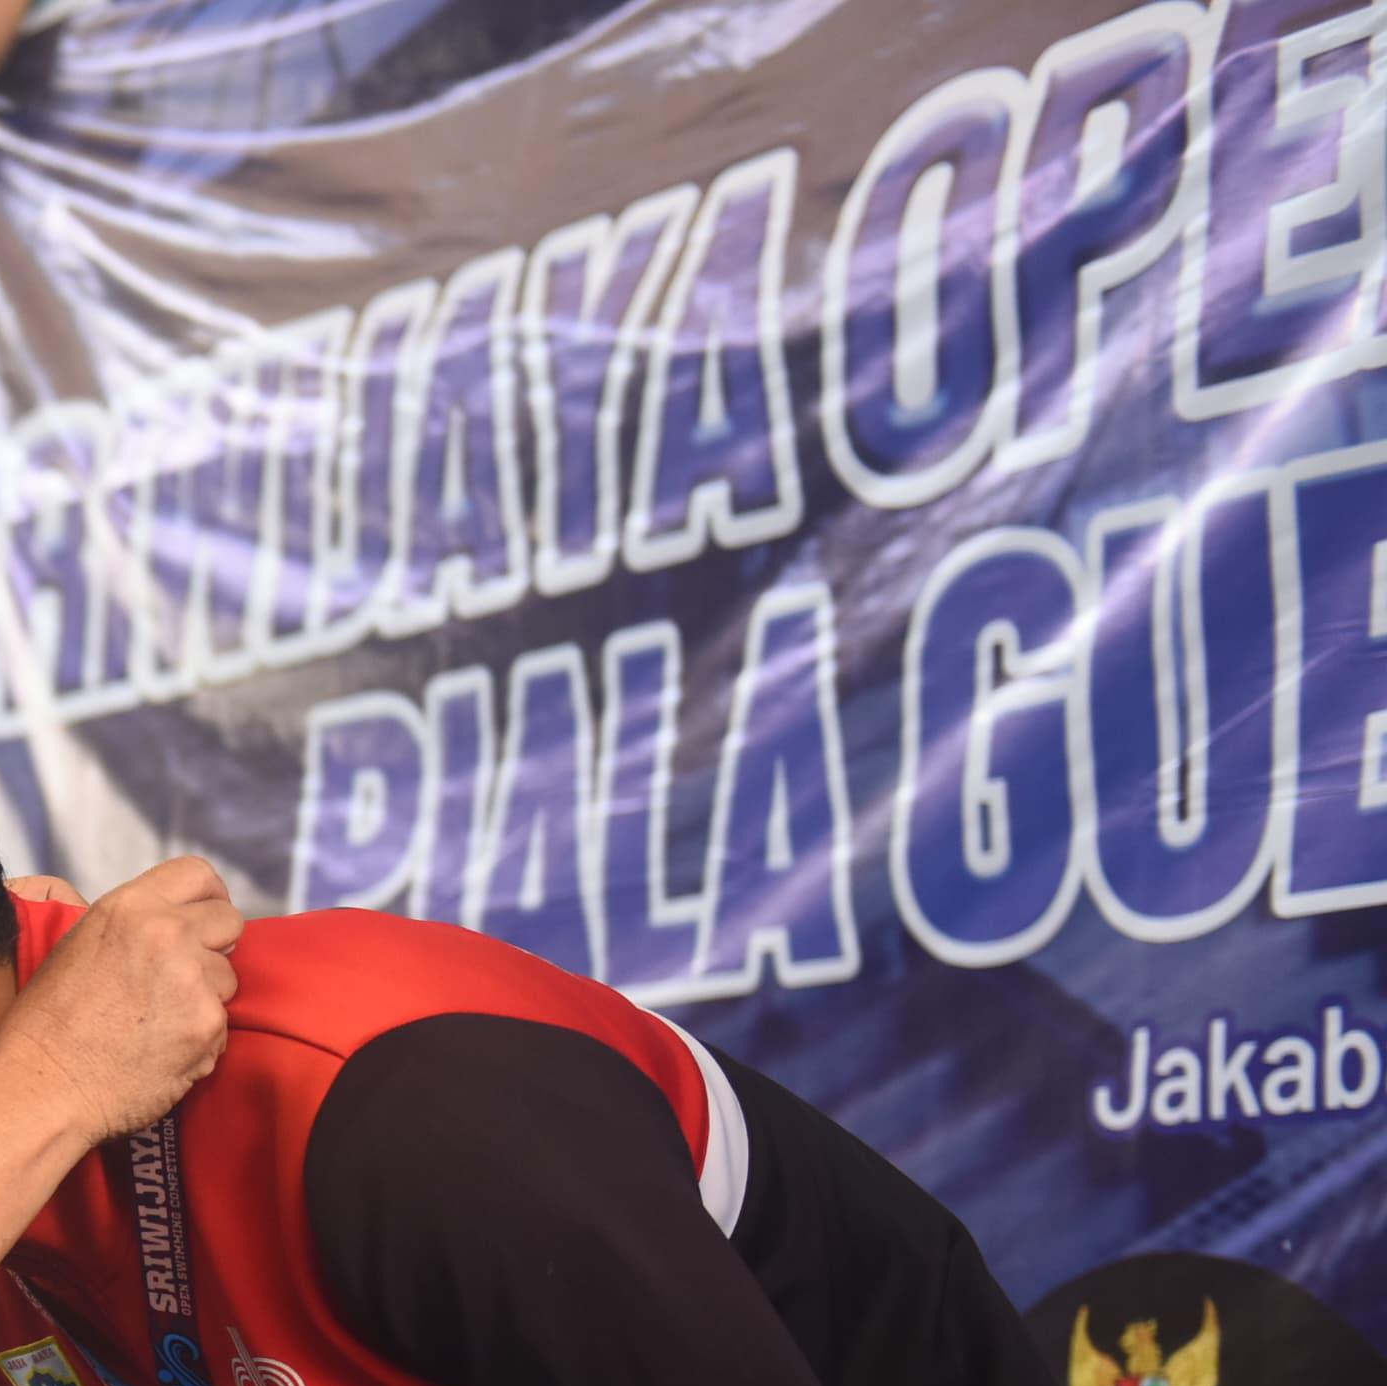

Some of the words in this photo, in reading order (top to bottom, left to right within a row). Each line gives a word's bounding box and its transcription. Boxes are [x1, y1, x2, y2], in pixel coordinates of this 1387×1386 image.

[822, 0, 1387, 509] OPE
[290, 578, 862, 1006] PIALA
[1092, 1004, 1387, 1133] Jakab
[162, 1117, 181, 1208] COMPETITION
[171, 1212, 188, 1281] SWIMMING
[178, 1282, 192, 1317] OPEN
